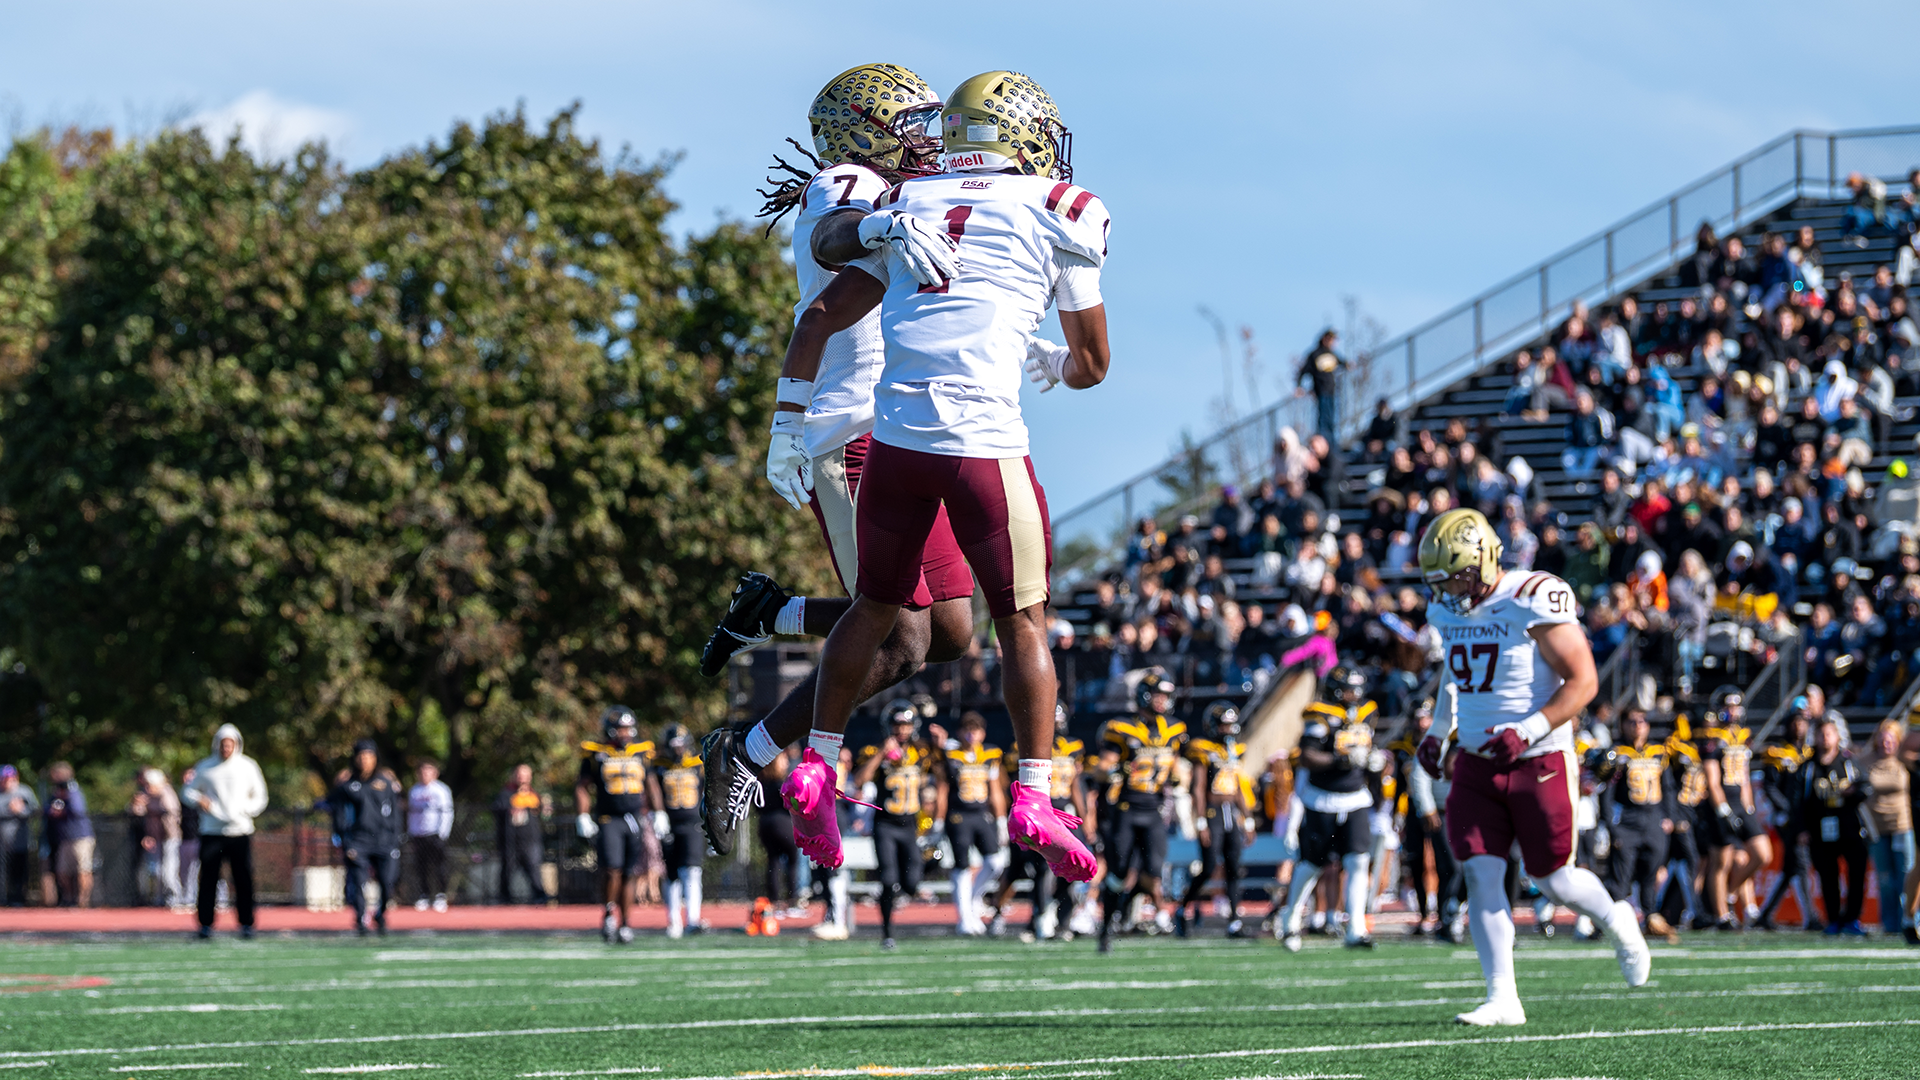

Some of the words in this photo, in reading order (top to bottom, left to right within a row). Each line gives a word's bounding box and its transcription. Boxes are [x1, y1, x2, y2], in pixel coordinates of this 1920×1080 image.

[947, 153, 984, 169] iddell
[833, 174, 859, 206] 7
[917, 205, 973, 294] 1
[1548, 590, 1569, 613] 97
[1449, 643, 1499, 693] 97
[884, 772, 921, 815] 31
